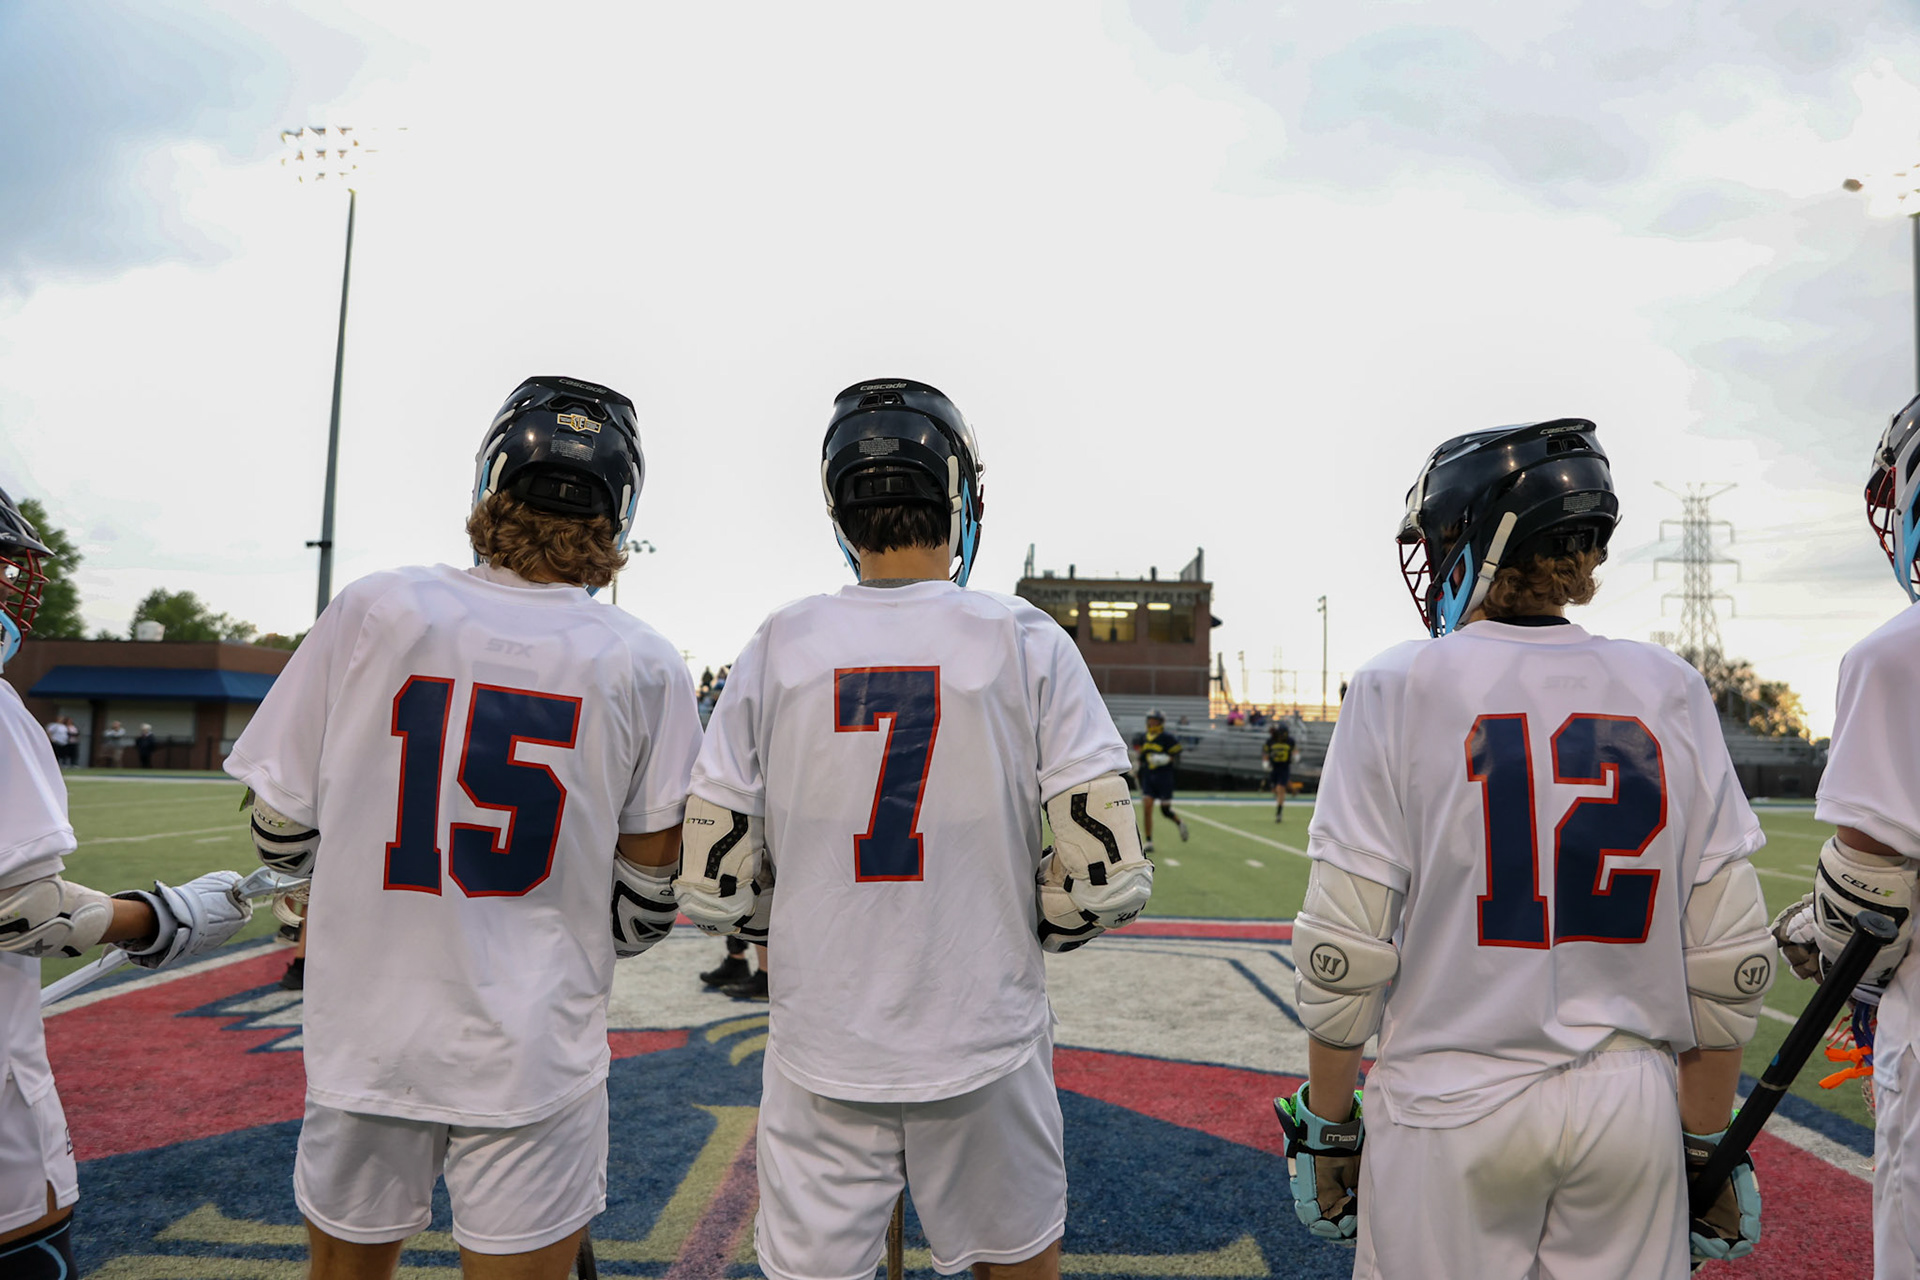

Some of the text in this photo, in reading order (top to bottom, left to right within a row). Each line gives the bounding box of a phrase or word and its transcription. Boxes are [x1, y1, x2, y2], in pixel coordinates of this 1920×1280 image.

[1035, 589, 1070, 601] SAINT
[1075, 589, 1139, 602] BENEDICT
[383, 674, 583, 898] 15
[834, 665, 941, 883] 7
[1463, 712, 1668, 950] 12
